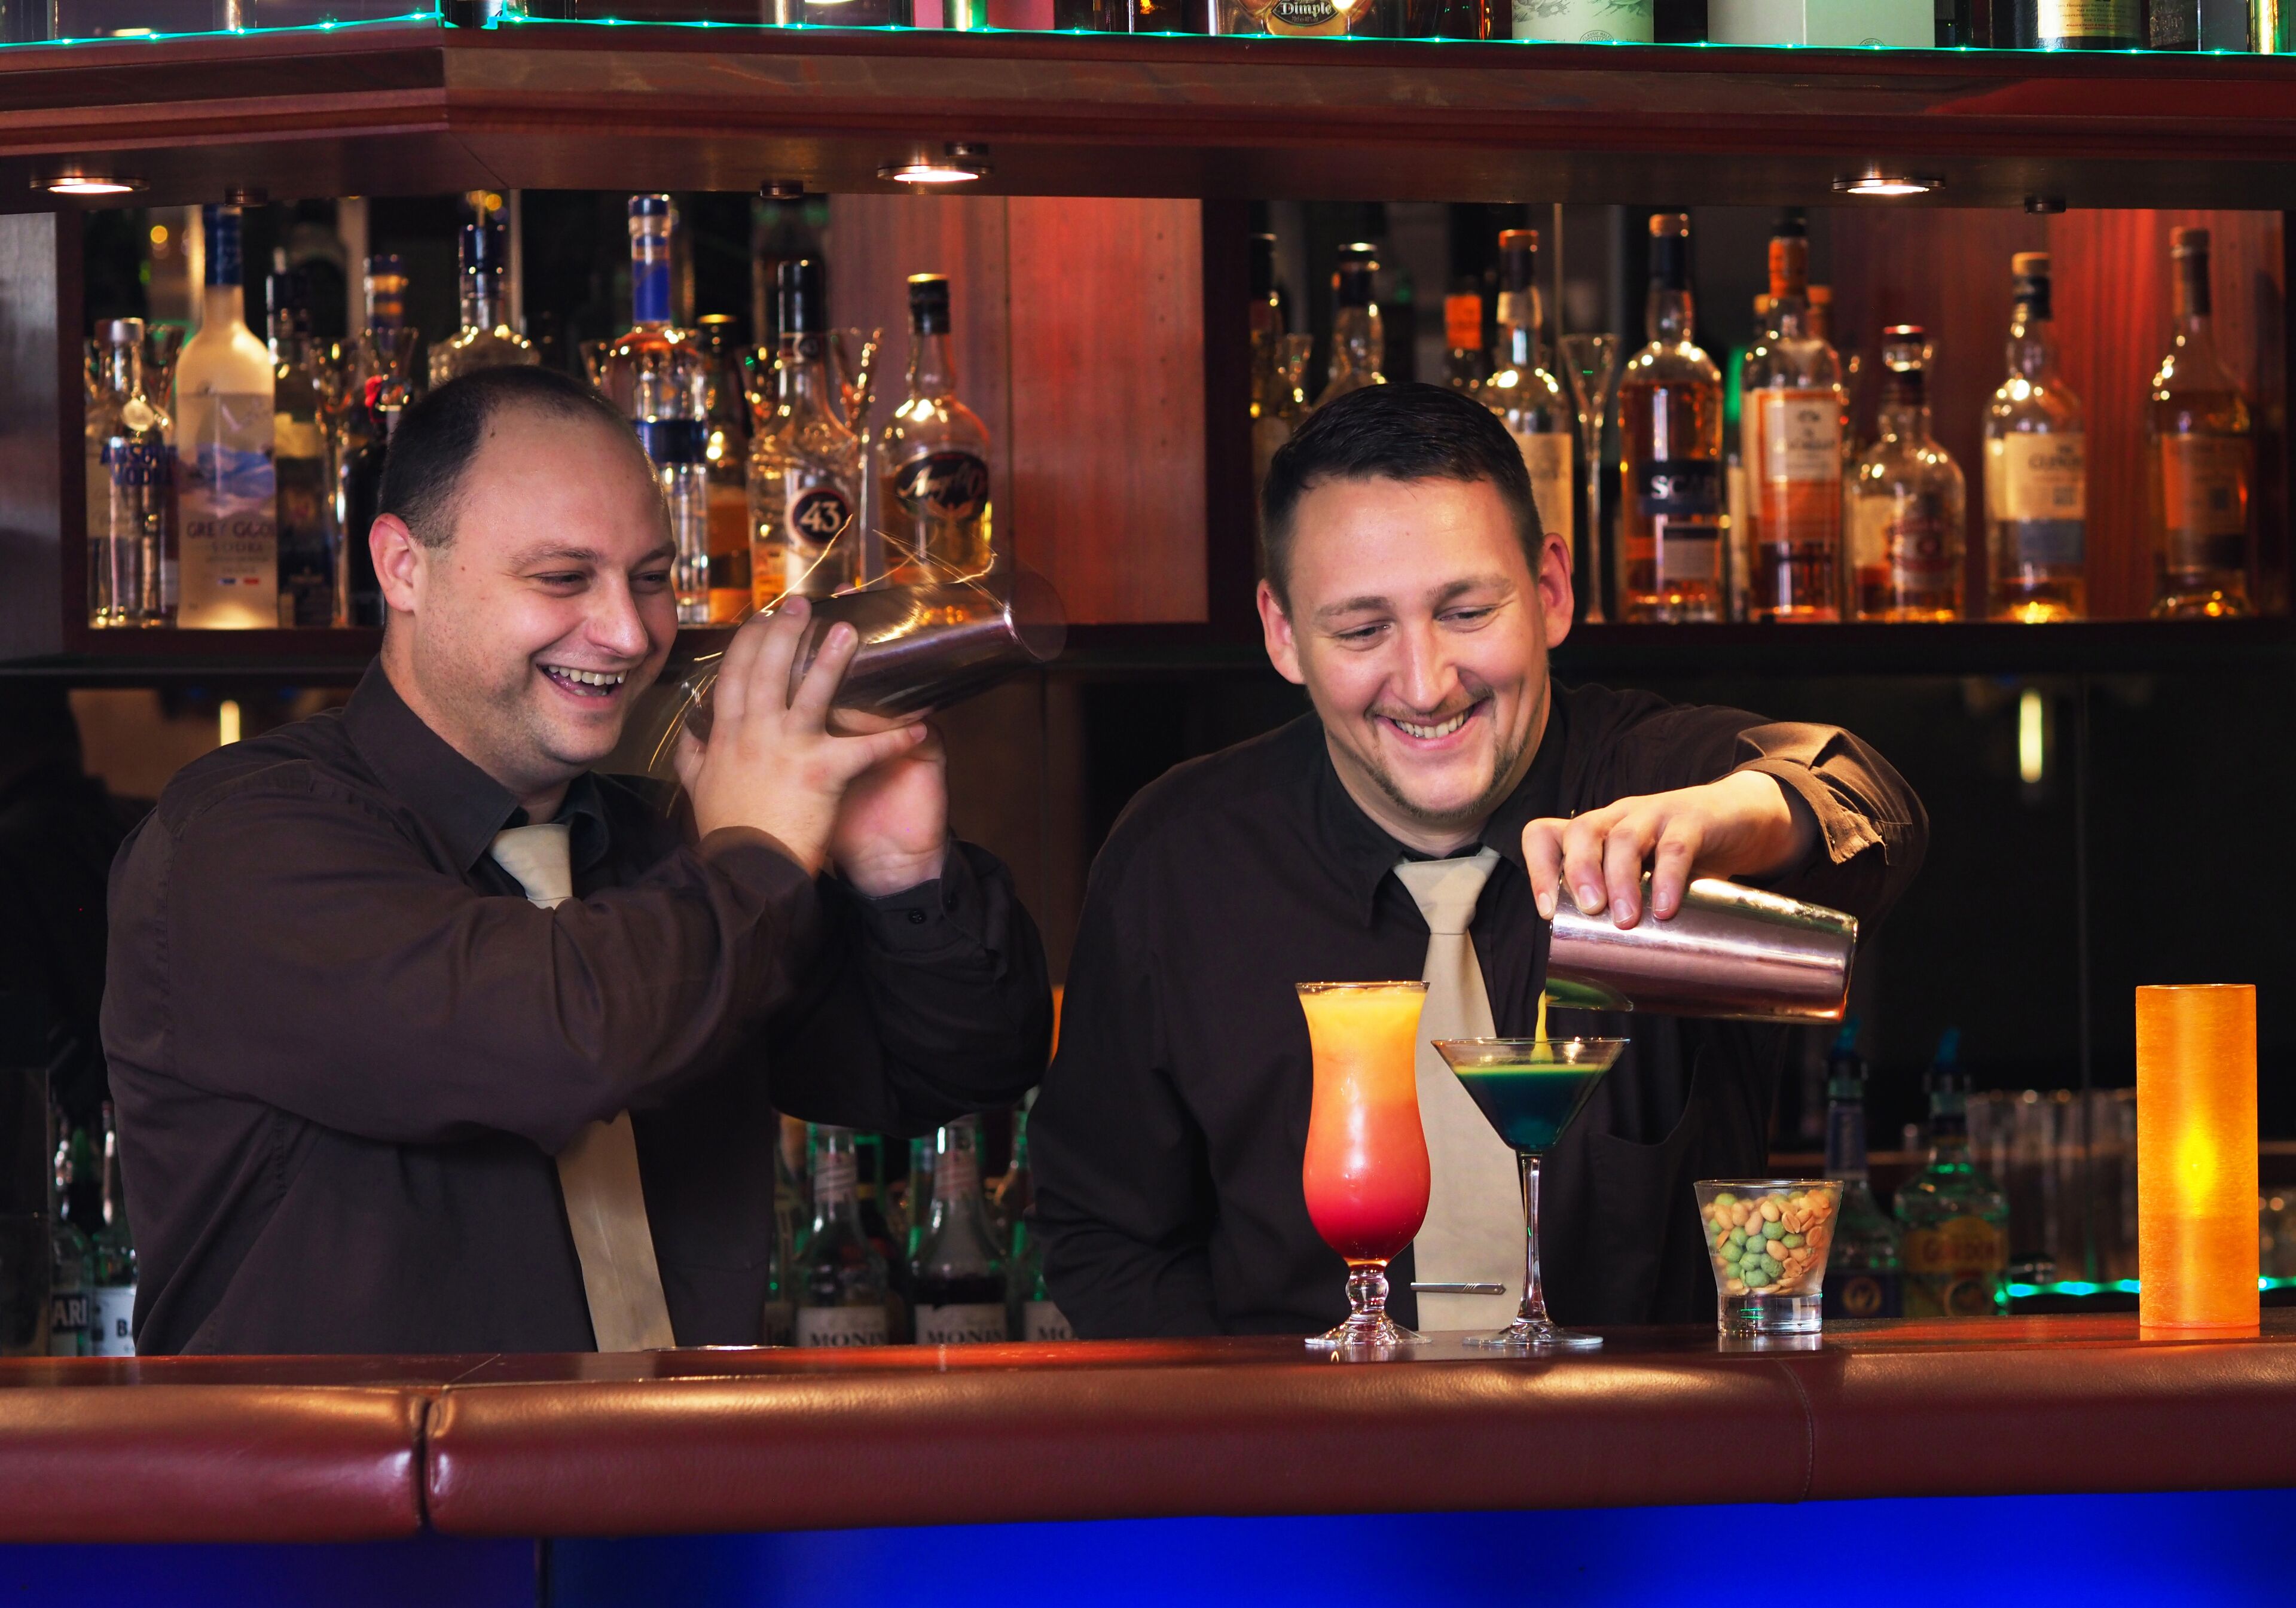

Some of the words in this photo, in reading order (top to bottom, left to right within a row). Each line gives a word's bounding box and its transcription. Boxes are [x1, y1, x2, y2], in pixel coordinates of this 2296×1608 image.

[1281, 2, 1332, 17] Dimple
[1582, 32, 1599, 41] CLASSIC
[799, 501, 841, 532] 43
[187, 521, 227, 538] GREY
